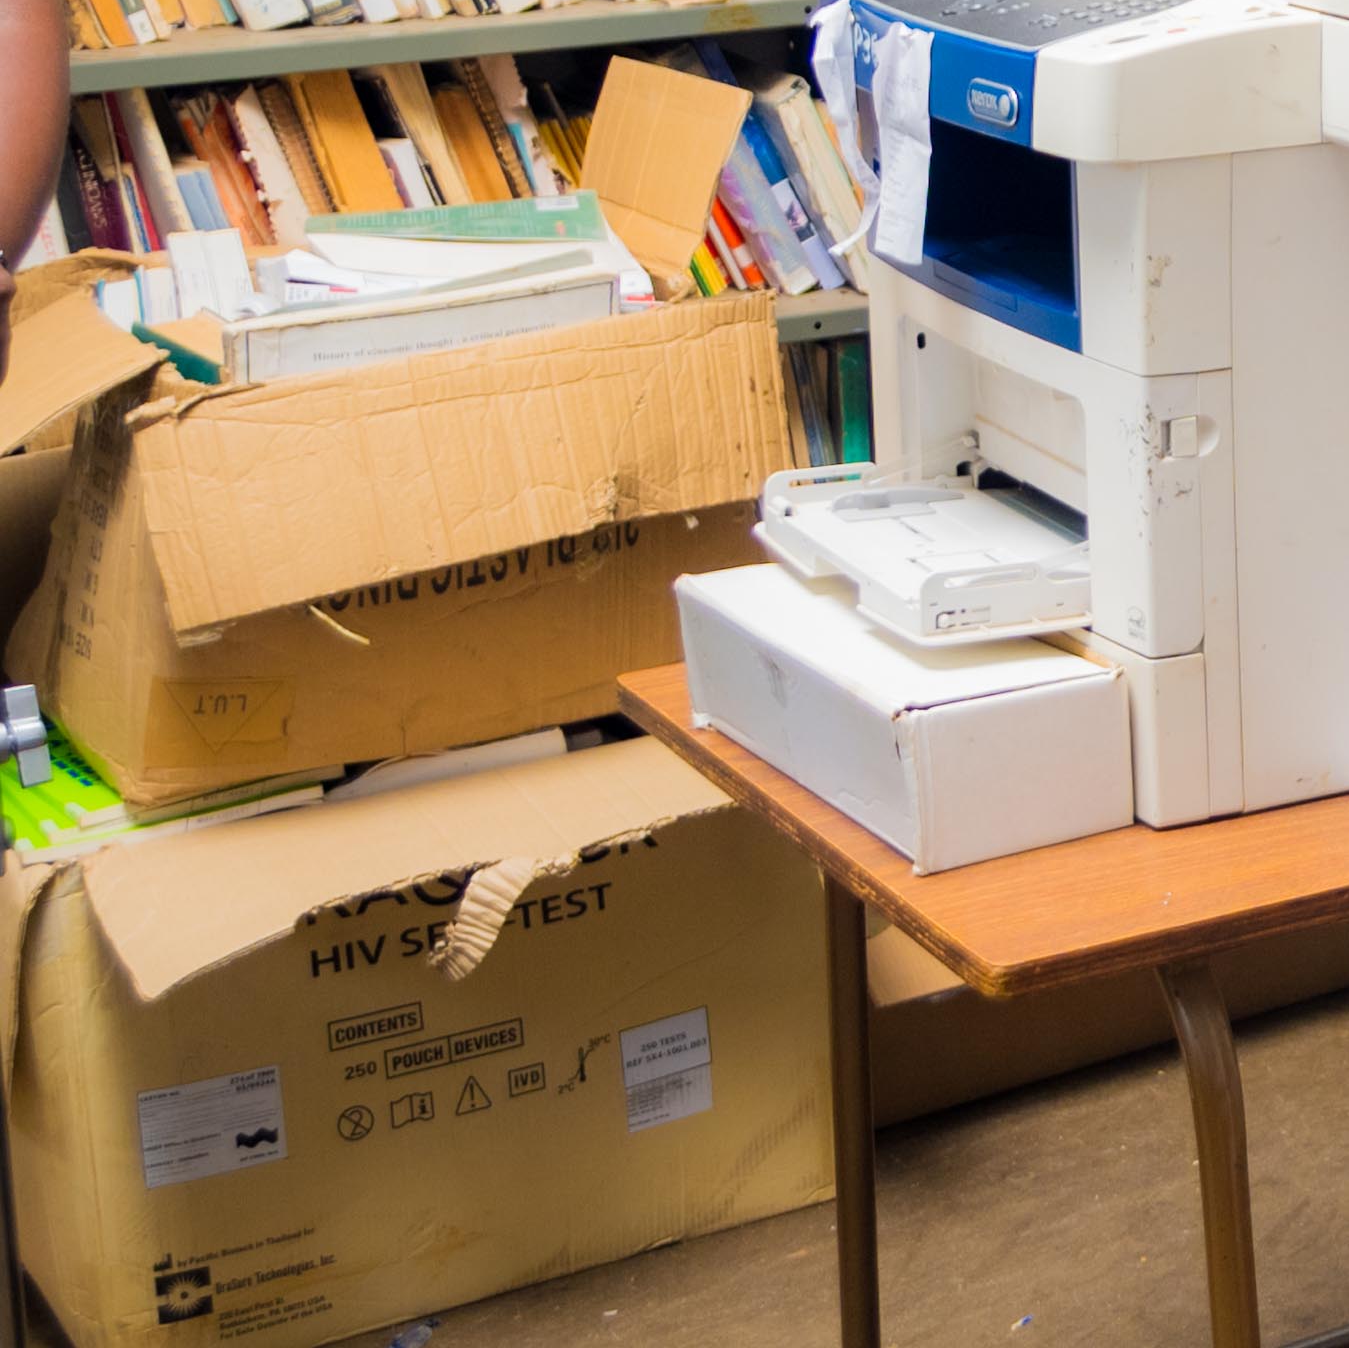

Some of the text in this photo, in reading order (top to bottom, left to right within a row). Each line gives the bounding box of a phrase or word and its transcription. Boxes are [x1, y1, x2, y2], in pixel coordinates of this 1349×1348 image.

[971, 88, 998, 111] xerox
[310, 882, 612, 978] HIV SE-TEST
[334, 1010, 419, 1045] CONTENTS
[660, 1032, 687, 1046] TESTS
[344, 1027, 518, 1081] 250 POUCH DEVICES
[513, 1071, 541, 1089] IVD
[215, 1275, 252, 1295] OraSure
